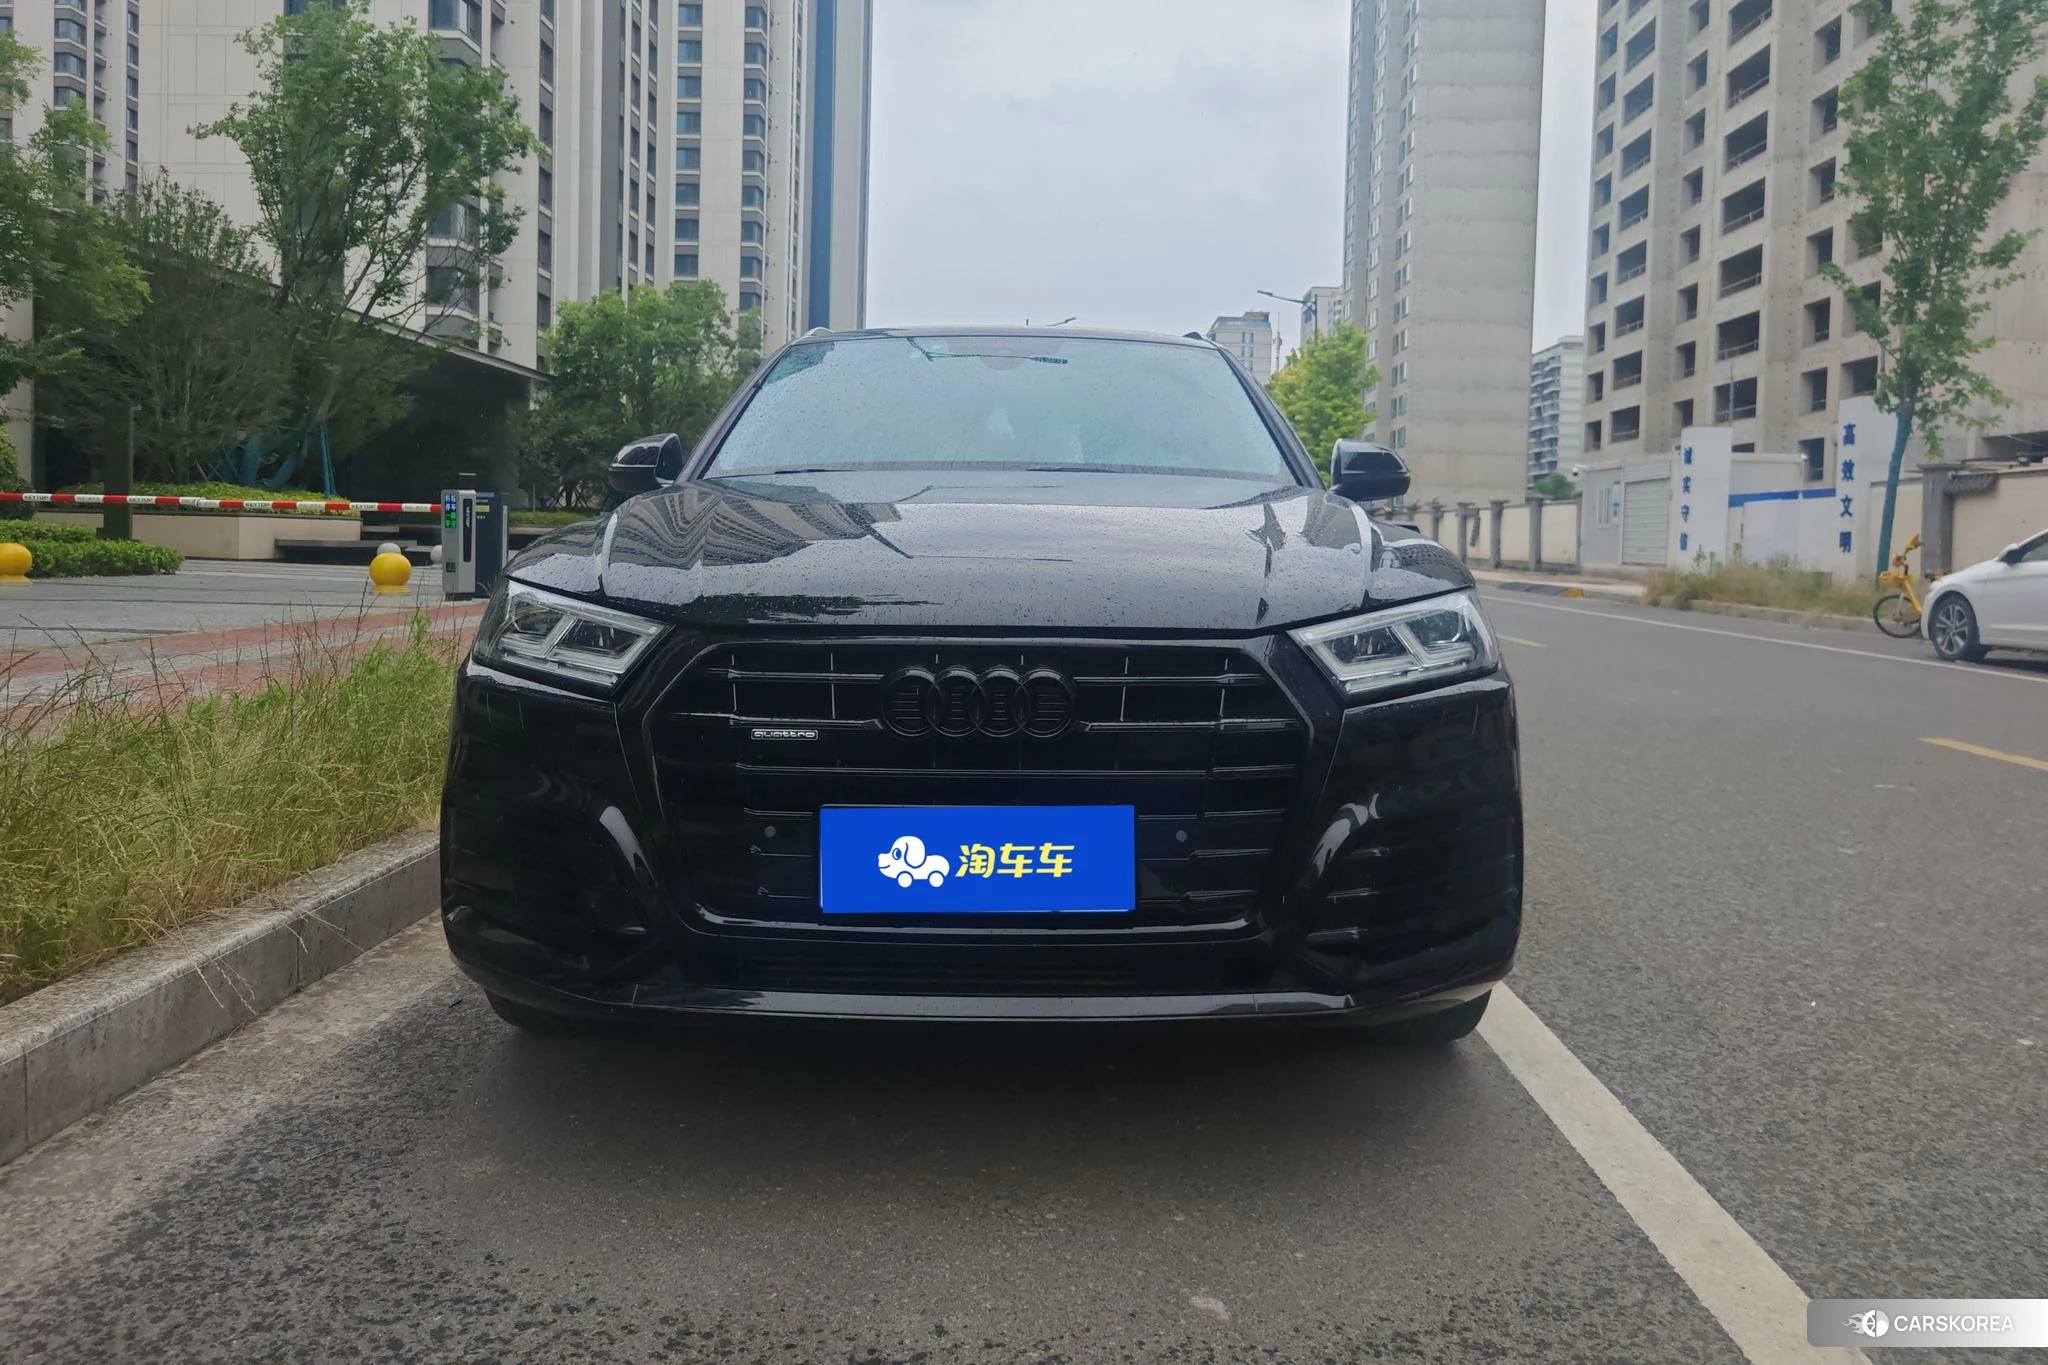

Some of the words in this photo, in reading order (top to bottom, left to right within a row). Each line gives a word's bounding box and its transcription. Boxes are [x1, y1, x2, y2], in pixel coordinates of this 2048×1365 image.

[1839, 422, 1856, 553] 高效文明
[753, 731, 816, 740] quattro
